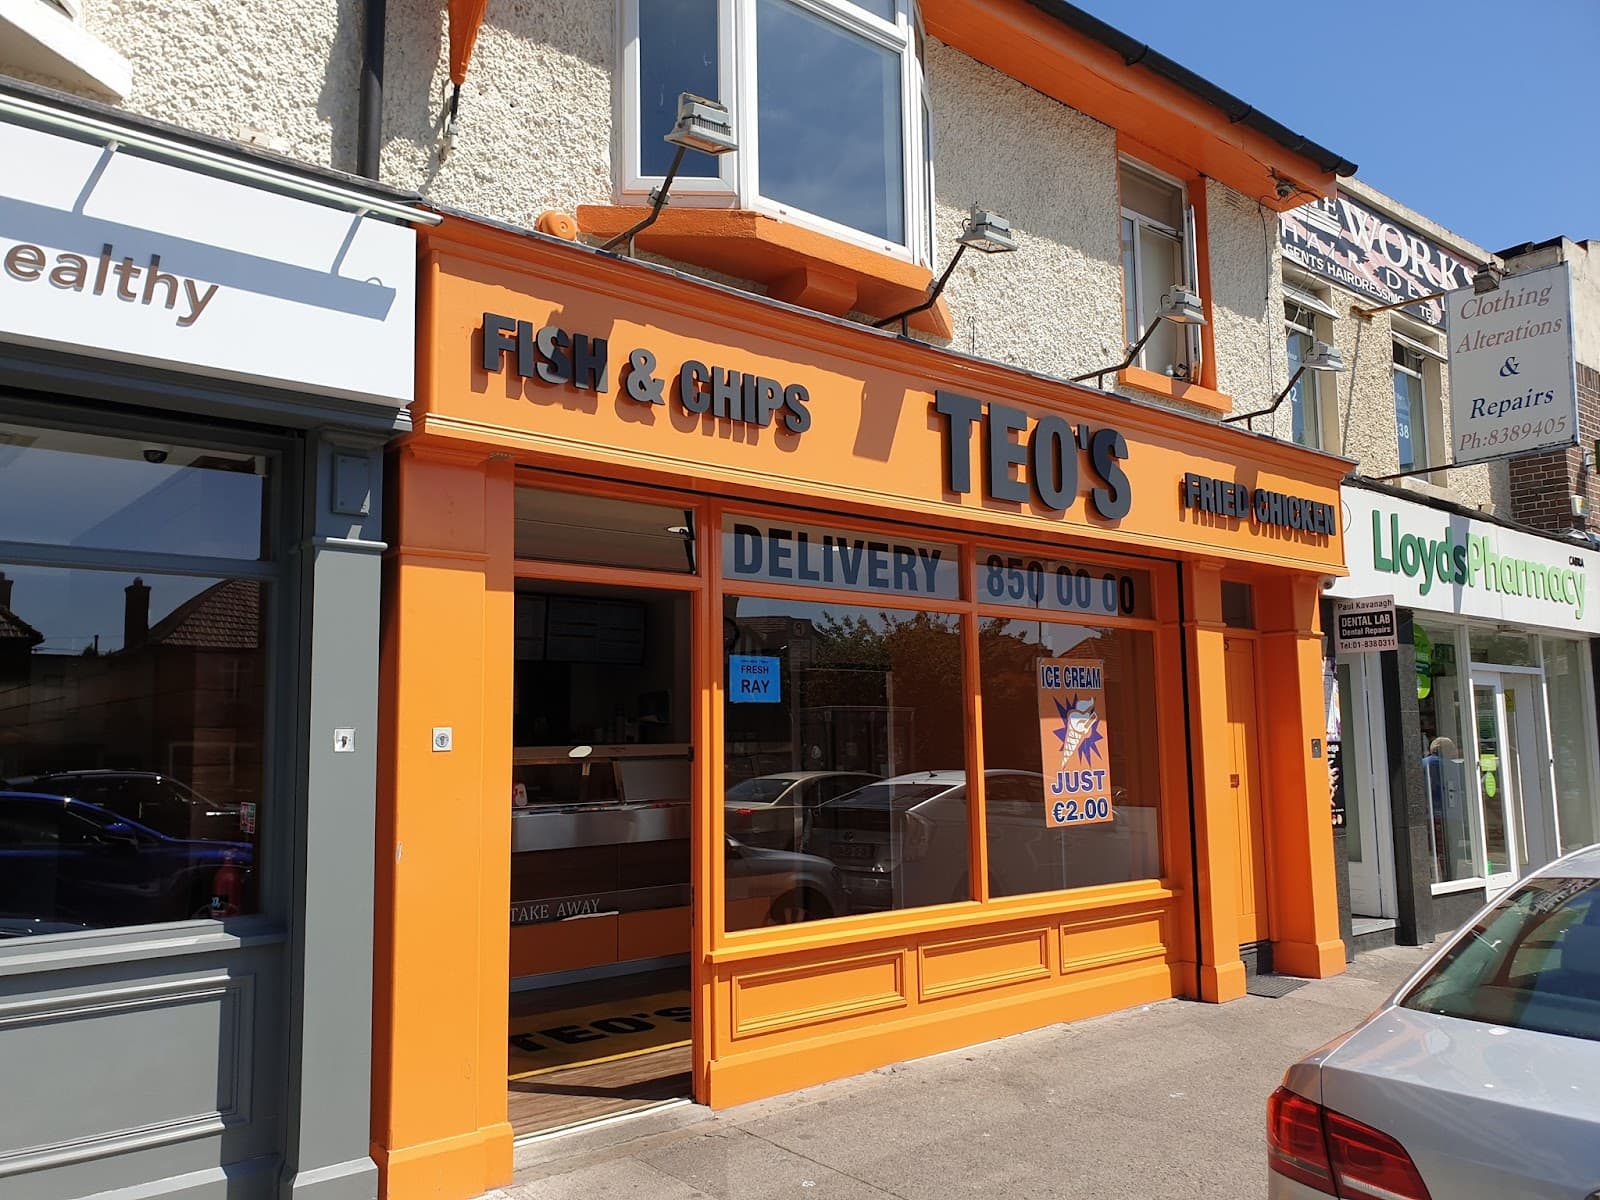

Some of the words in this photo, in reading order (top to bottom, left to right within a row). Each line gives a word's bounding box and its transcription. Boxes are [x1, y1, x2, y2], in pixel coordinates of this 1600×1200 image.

[1285, 243, 1325, 271] GENTS
[4, 243, 219, 328] ealthy
[1460, 285, 1553, 320] Clothing
[1456, 317, 1562, 354] Alterations
[482, 312, 608, 393] FISH
[626, 347, 665, 406] &
[679, 359, 812, 434] CHIPS
[1499, 356, 1520, 377] &
[1470, 388, 1554, 420] Repairs
[1459, 415, 1568, 451] Ph:8389405
[934, 389, 1132, 520] TEO'S
[1184, 472, 1249, 519] FRIED
[1255, 488, 1336, 536] CHICKEN
[733, 522, 942, 594] DELIVERY
[986, 554, 1045, 602] 850
[1055, 564, 1092, 610] 00
[1102, 572, 1135, 616] 00
[1356, 599, 1392, 609] Kavanagh
[1341, 615, 1373, 628] DENTAL
[1374, 613, 1391, 625] LAB
[1342, 627, 1364, 637] Dental
[1364, 626, 1392, 636] Repairs
[740, 664, 769, 675] FRESH
[1041, 666, 1061, 689] ICE
[1063, 666, 1101, 689] CREAM
[741, 679, 770, 694] RAY
[1051, 770, 1105, 794] JUST
[1053, 798, 1109, 823] €2.00
[511, 904, 549, 922] TAKE
[556, 898, 600, 917] AWAY
